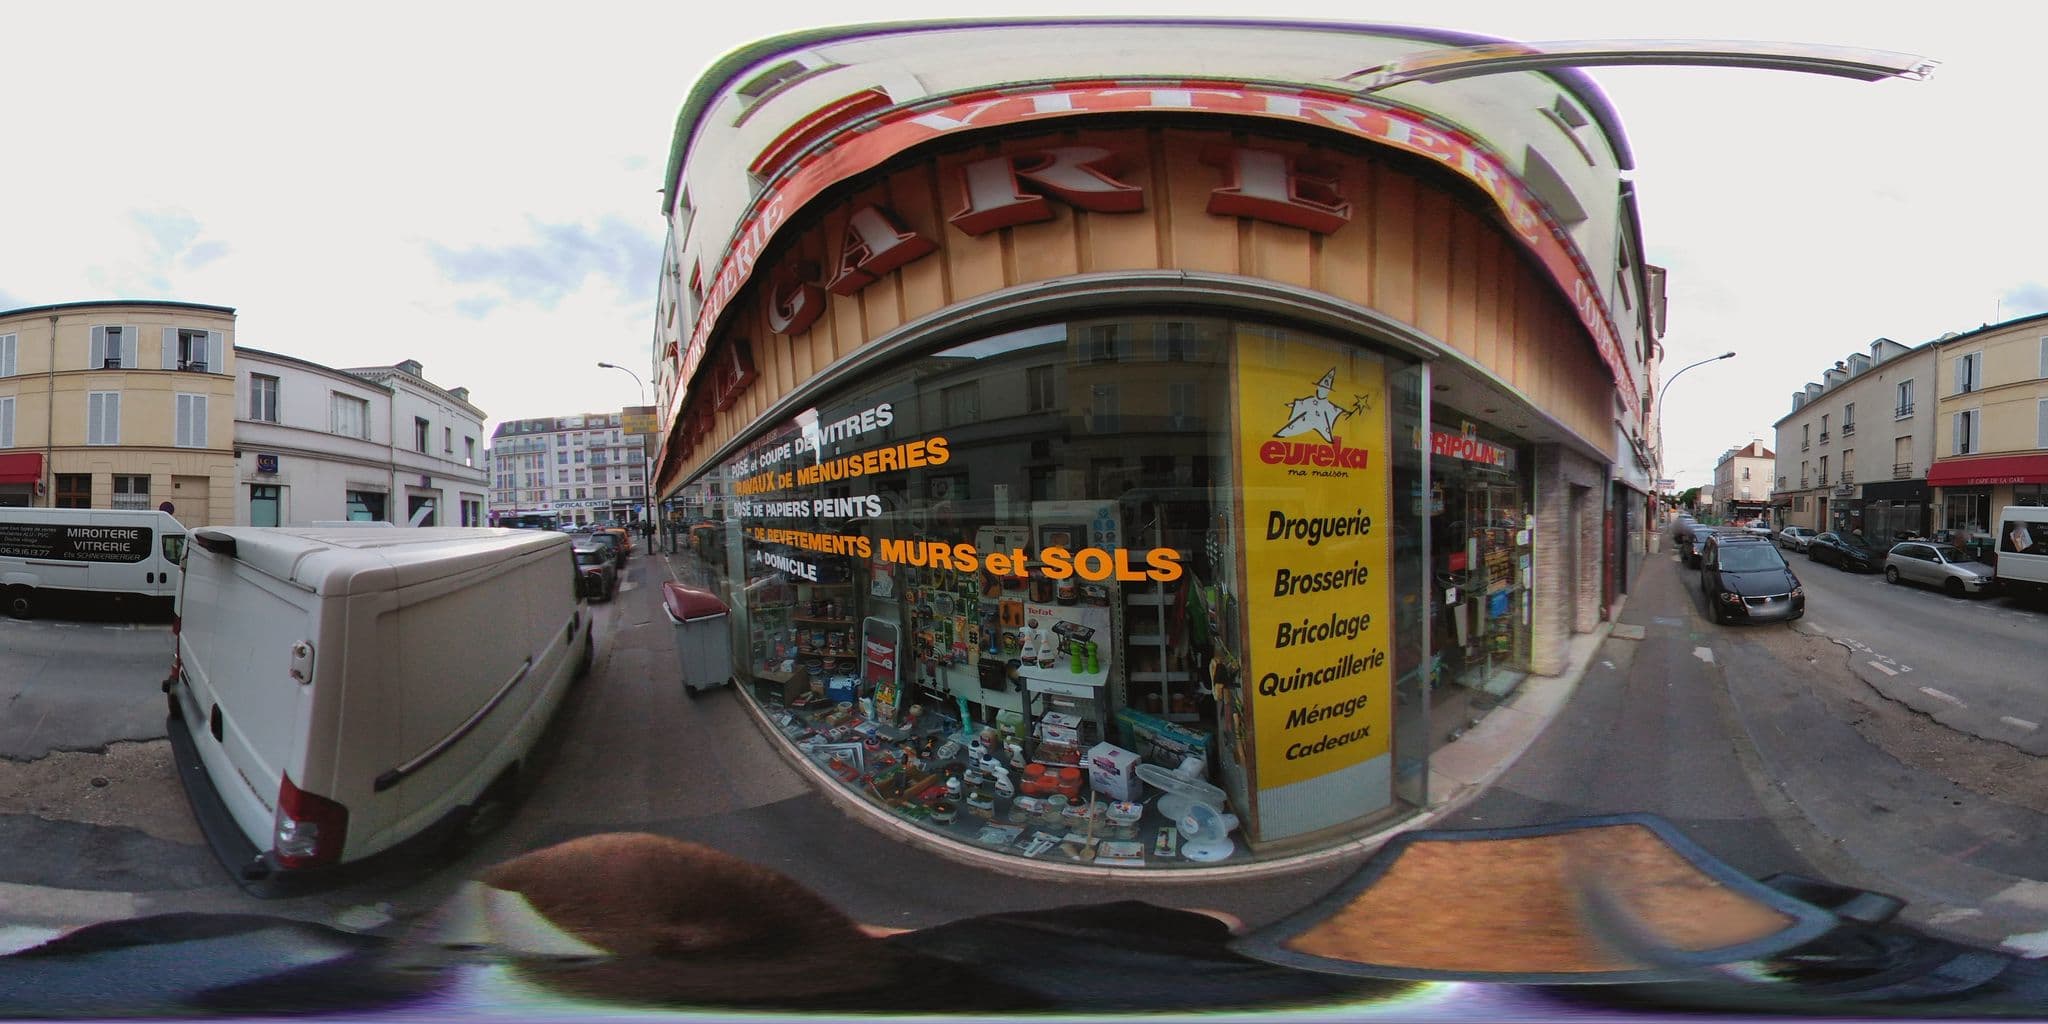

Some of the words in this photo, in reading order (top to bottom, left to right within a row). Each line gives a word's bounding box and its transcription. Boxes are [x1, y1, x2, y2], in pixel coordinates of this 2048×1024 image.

[910, 89, 1540, 244] VITRERIE
[767, 146, 1352, 335] GARE
[731, 458, 749, 480] POSE
[750, 459, 758, 472] et
[760, 442, 791, 468] COUPE
[818, 403, 894, 447] VITRES
[1259, 436, 1369, 470] eureka
[732, 470, 776, 498] RAVAUX
[778, 472, 793, 490] DE
[797, 437, 950, 487] MENUISERIES
[1287, 468, 1307, 477] ma
[1312, 467, 1349, 478] maison
[2008, 476, 2025, 484] GARE
[733, 500, 751, 518] POSE
[753, 504, 764, 517] DE
[766, 500, 810, 518] PAPIERS
[814, 494, 882, 518] PEINTS
[67, 528, 138, 539] MIROITERIE
[1266, 508, 1371, 546] Droguerie
[73, 541, 131, 552] VITRERIE
[754, 526, 765, 541] DE
[767, 528, 872, 558] REVETEMENTS
[880, 538, 979, 573] MURS
[985, 547, 1029, 578] et
[1040, 546, 1183, 582] SOLS
[764, 552, 818, 583] DOMICILE
[1274, 560, 1368, 597] Brosserie
[1027, 606, 1054, 617] Tefal
[1275, 613, 1370, 649] Bricolage
[1258, 648, 1385, 697] Quincaillerie
[1285, 694, 1368, 730] Ménage
[1285, 725, 1371, 761] Cadeaux
